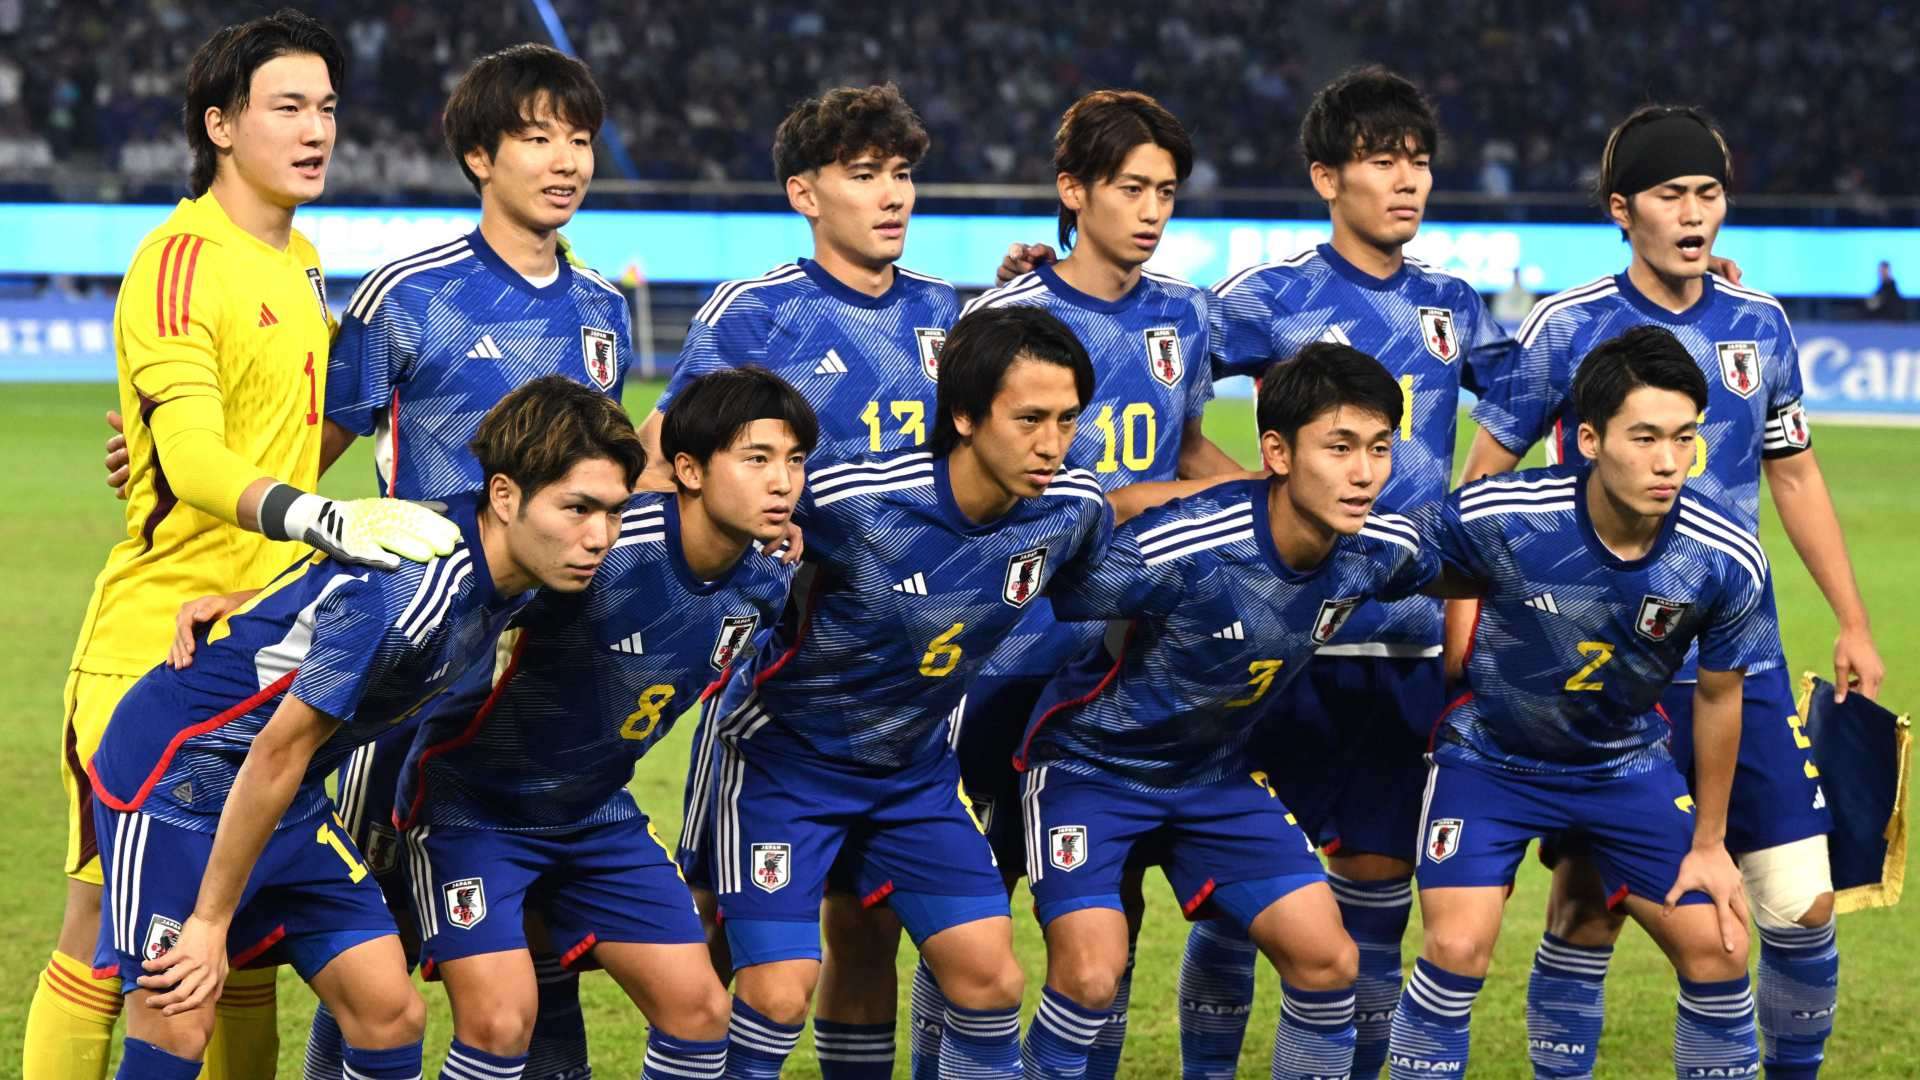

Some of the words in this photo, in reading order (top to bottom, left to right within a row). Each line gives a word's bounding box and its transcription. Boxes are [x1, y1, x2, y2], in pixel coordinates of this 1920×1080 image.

[304, 351, 318, 425] 1
[1094, 402, 1157, 474] 10
[919, 622, 964, 677] 6
[1564, 641, 1615, 690] 2
[1224, 659, 1283, 708] 3
[619, 684, 676, 740] 8
[452, 880, 472, 888] JAPAN
[762, 876, 779, 885] JFA
[1391, 1055, 1460, 1072] JAPAN
[1529, 1040, 1584, 1054] APAN
